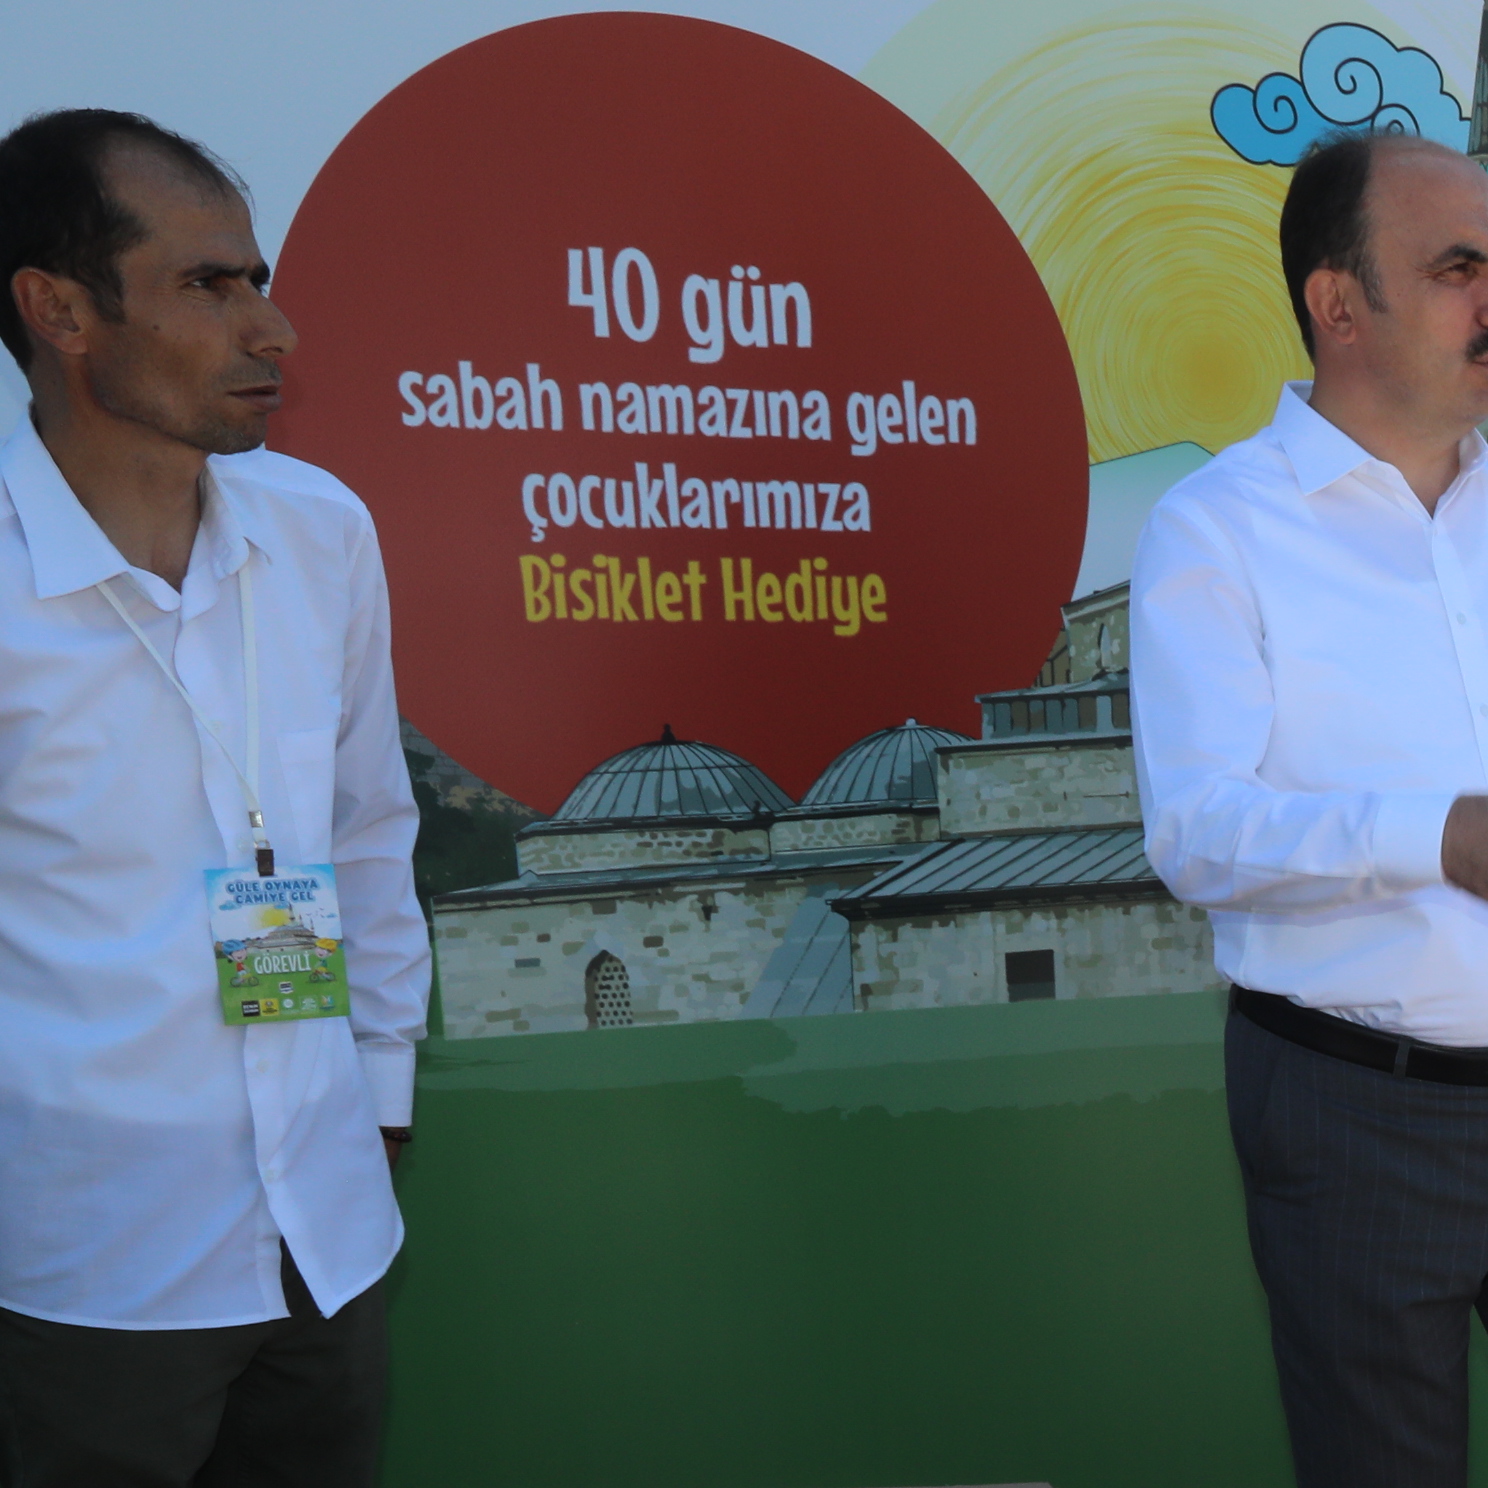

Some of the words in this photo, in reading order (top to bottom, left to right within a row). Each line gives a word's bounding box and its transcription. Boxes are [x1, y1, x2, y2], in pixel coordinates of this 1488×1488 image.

[566, 246, 659, 343] 40
[681, 265, 813, 365] gün
[398, 361, 564, 434] sabah
[580, 380, 832, 441] namazına
[847, 381, 978, 457] gelen
[521, 462, 872, 542] çocuklarımıza
[520, 555, 706, 623] Bisiklet
[722, 557, 888, 637] Hediye
[265, 879, 319, 890] OYNAYA
[254, 951, 312, 975] GÖREVLİ
